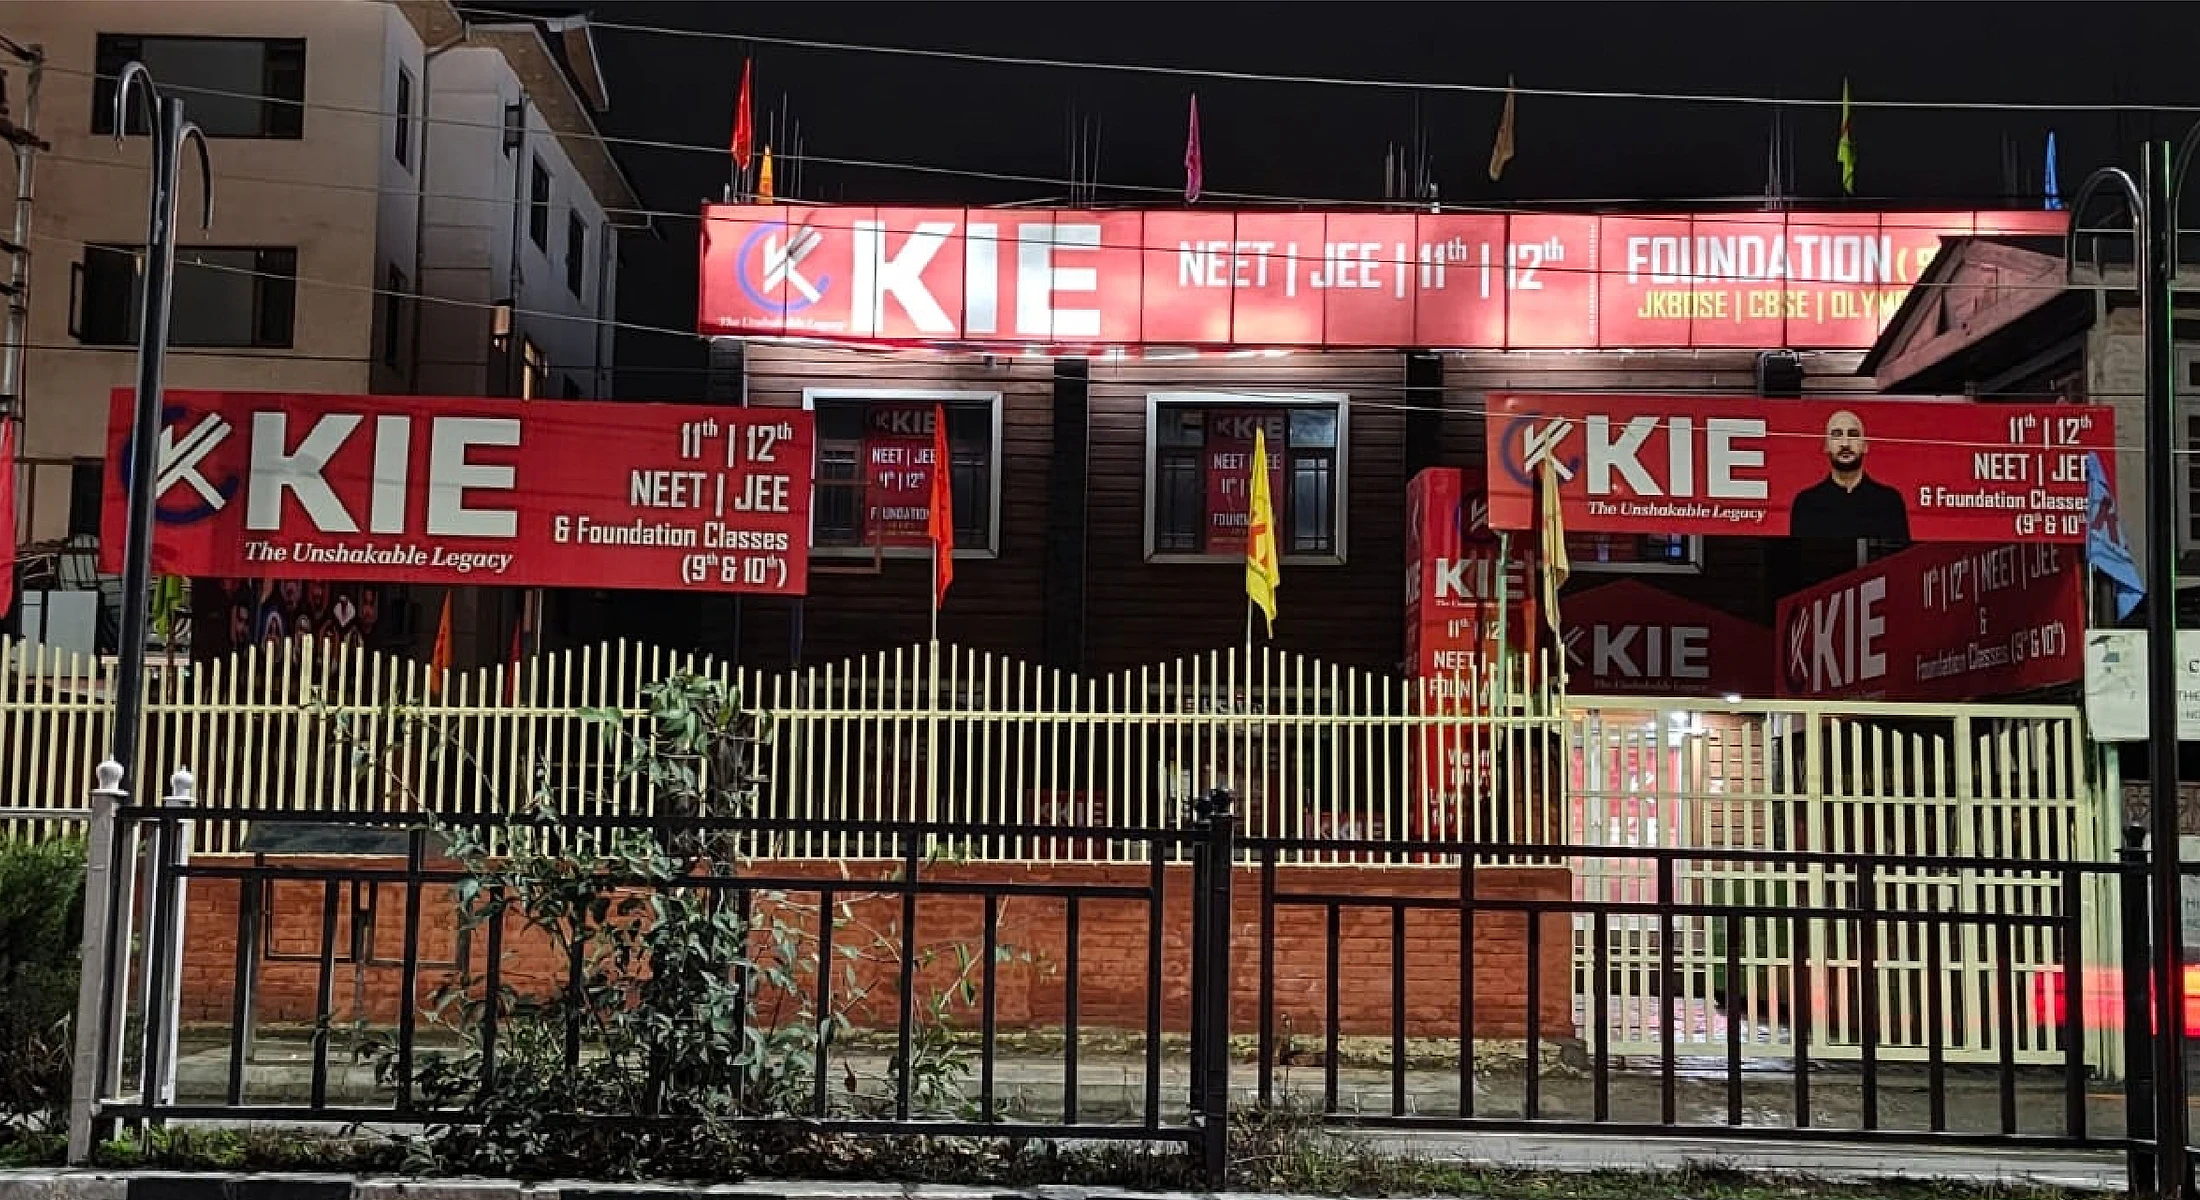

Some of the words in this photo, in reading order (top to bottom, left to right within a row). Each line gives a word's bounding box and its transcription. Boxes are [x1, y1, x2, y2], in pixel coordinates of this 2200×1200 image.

[1627, 235, 1893, 285] FOUNDATION
[852, 220, 1100, 336] KIE
[1179, 240, 1274, 288] NEET
[1310, 242, 1382, 289] JEE
[1419, 236, 1467, 290] 11th
[1507, 235, 1565, 290] 12th
[1638, 290, 1728, 319] JKBOSE
[1750, 290, 1809, 320] CBSE
[892, 410, 936, 434] KIE
[2010, 413, 2036, 444] 11th
[2057, 414, 2092, 445] 12th
[682, 417, 718, 459] 11th
[747, 420, 792, 462] 12th
[872, 448, 904, 464] NEET
[1587, 415, 1768, 499] KIE
[1974, 452, 2030, 481] NEET
[246, 411, 521, 538] KIE
[630, 469, 707, 508] NEET
[734, 474, 790, 513] JEE
[870, 506, 930, 520] FUNDATIO
[1589, 501, 1617, 516] The
[1621, 502, 1710, 519] Unshakable
[1712, 504, 1766, 523] Legacy
[1937, 487, 2026, 508] Foundation
[577, 516, 697, 547] Foundation
[704, 521, 788, 550] Classes
[245, 541, 287, 562] The
[292, 543, 427, 567] Unshakable
[430, 548, 514, 574] Legacy
[1982, 544, 2018, 592] NEET
[2031, 543, 2060, 578] JEE
[1435, 558, 1524, 599] KIE
[1813, 576, 1886, 692] KIE
[1434, 651, 1475, 669] NEET
[1593, 625, 1710, 678] KIE
